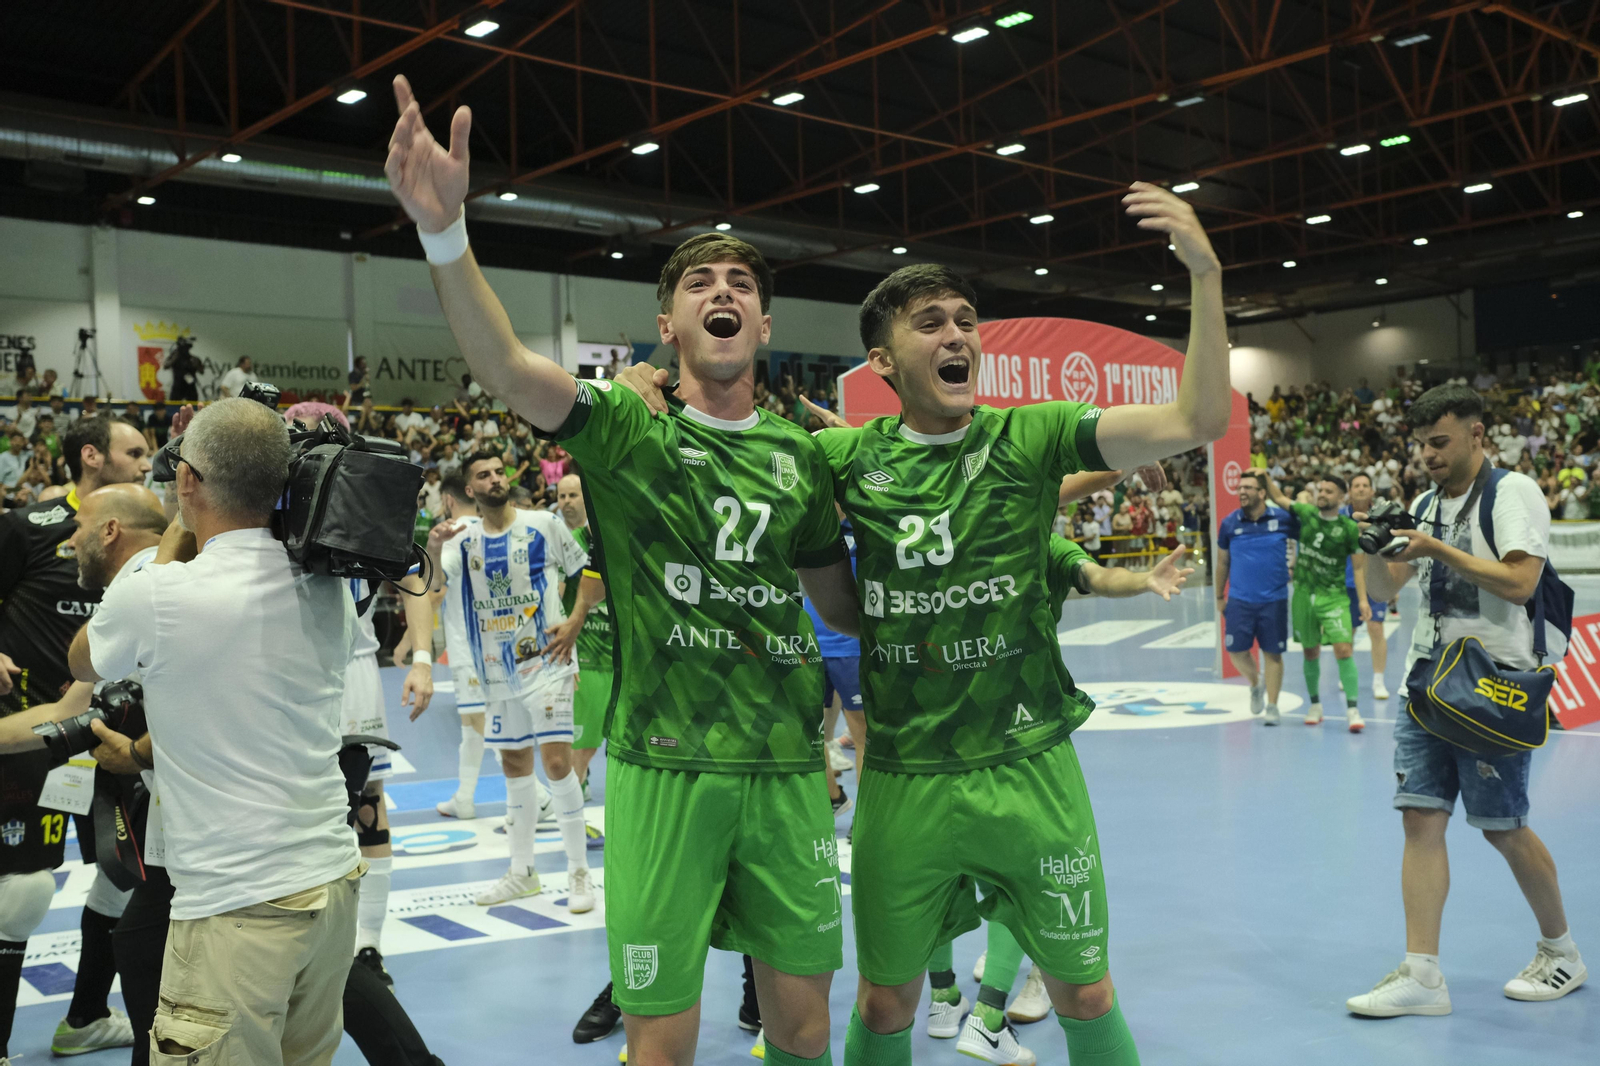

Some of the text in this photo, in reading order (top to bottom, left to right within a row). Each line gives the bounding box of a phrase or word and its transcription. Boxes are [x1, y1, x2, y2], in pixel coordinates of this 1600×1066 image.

[977, 352, 1053, 400] MOS DE
[1122, 364, 1178, 405] FUTSAL
[864, 483, 890, 493] umbro
[713, 496, 770, 563] 27
[1313, 532, 1324, 548] 2
[473, 592, 539, 611] CAJA RURAL
[889, 574, 1020, 615] BESOCCER
[480, 614, 525, 632] ZAMORA
[953, 660, 981, 671] Directa
[1474, 677, 1528, 712] SER
[492, 715, 502, 734] 5
[41, 814, 64, 845] 13
[115, 805, 128, 841] Canon
[1054, 872, 1090, 888] viajes
[1040, 928, 1071, 940] diputación
[1071, 931, 1080, 940] de
[632, 950, 652, 959] CLUB
[633, 963, 651, 971] UMA
